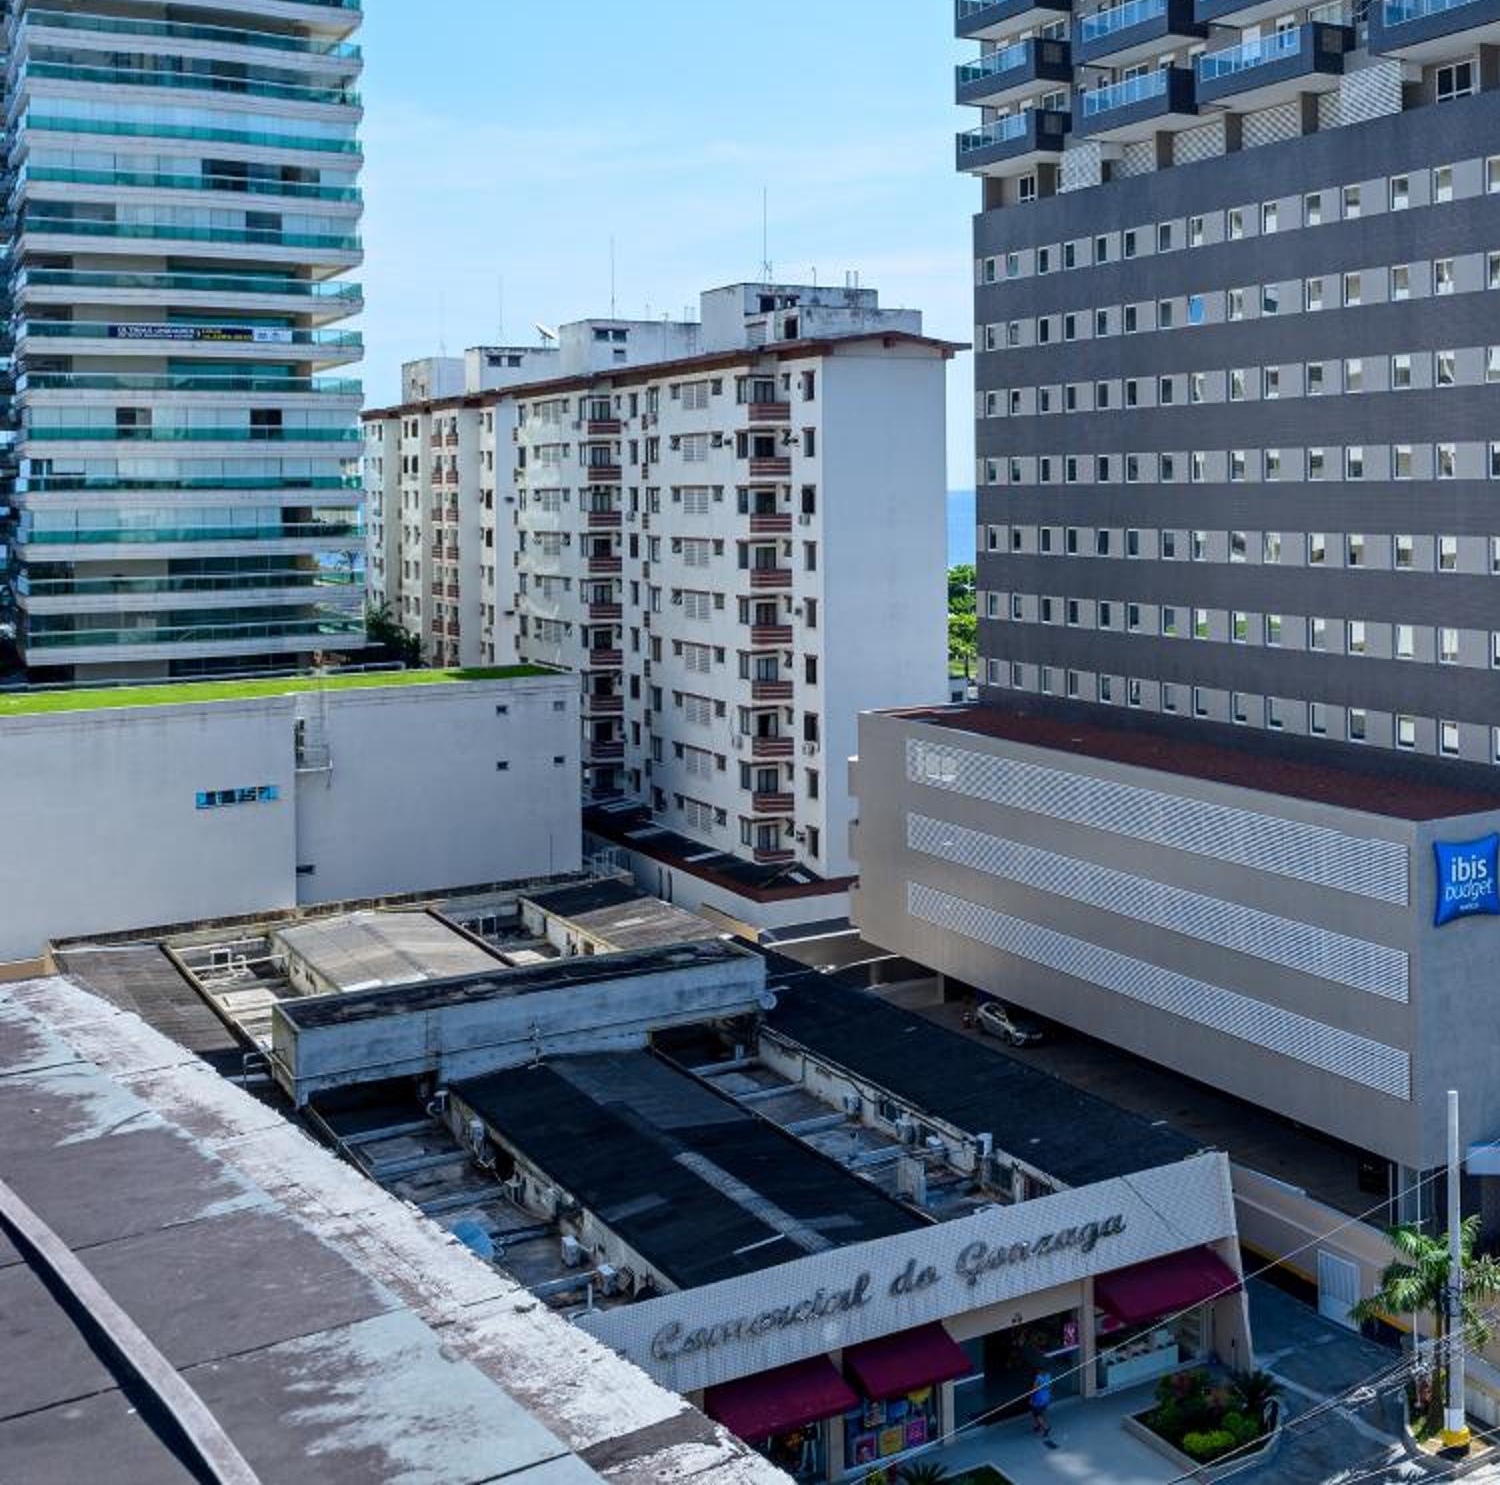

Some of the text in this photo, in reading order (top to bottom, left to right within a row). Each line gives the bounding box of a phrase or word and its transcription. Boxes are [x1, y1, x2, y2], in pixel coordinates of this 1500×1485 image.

[1451, 854, 1487, 883] ibis
[1445, 877, 1496, 902] budget
[652, 1271, 873, 1361] Comercial
[956, 1214, 1127, 1288] Gonzaga
